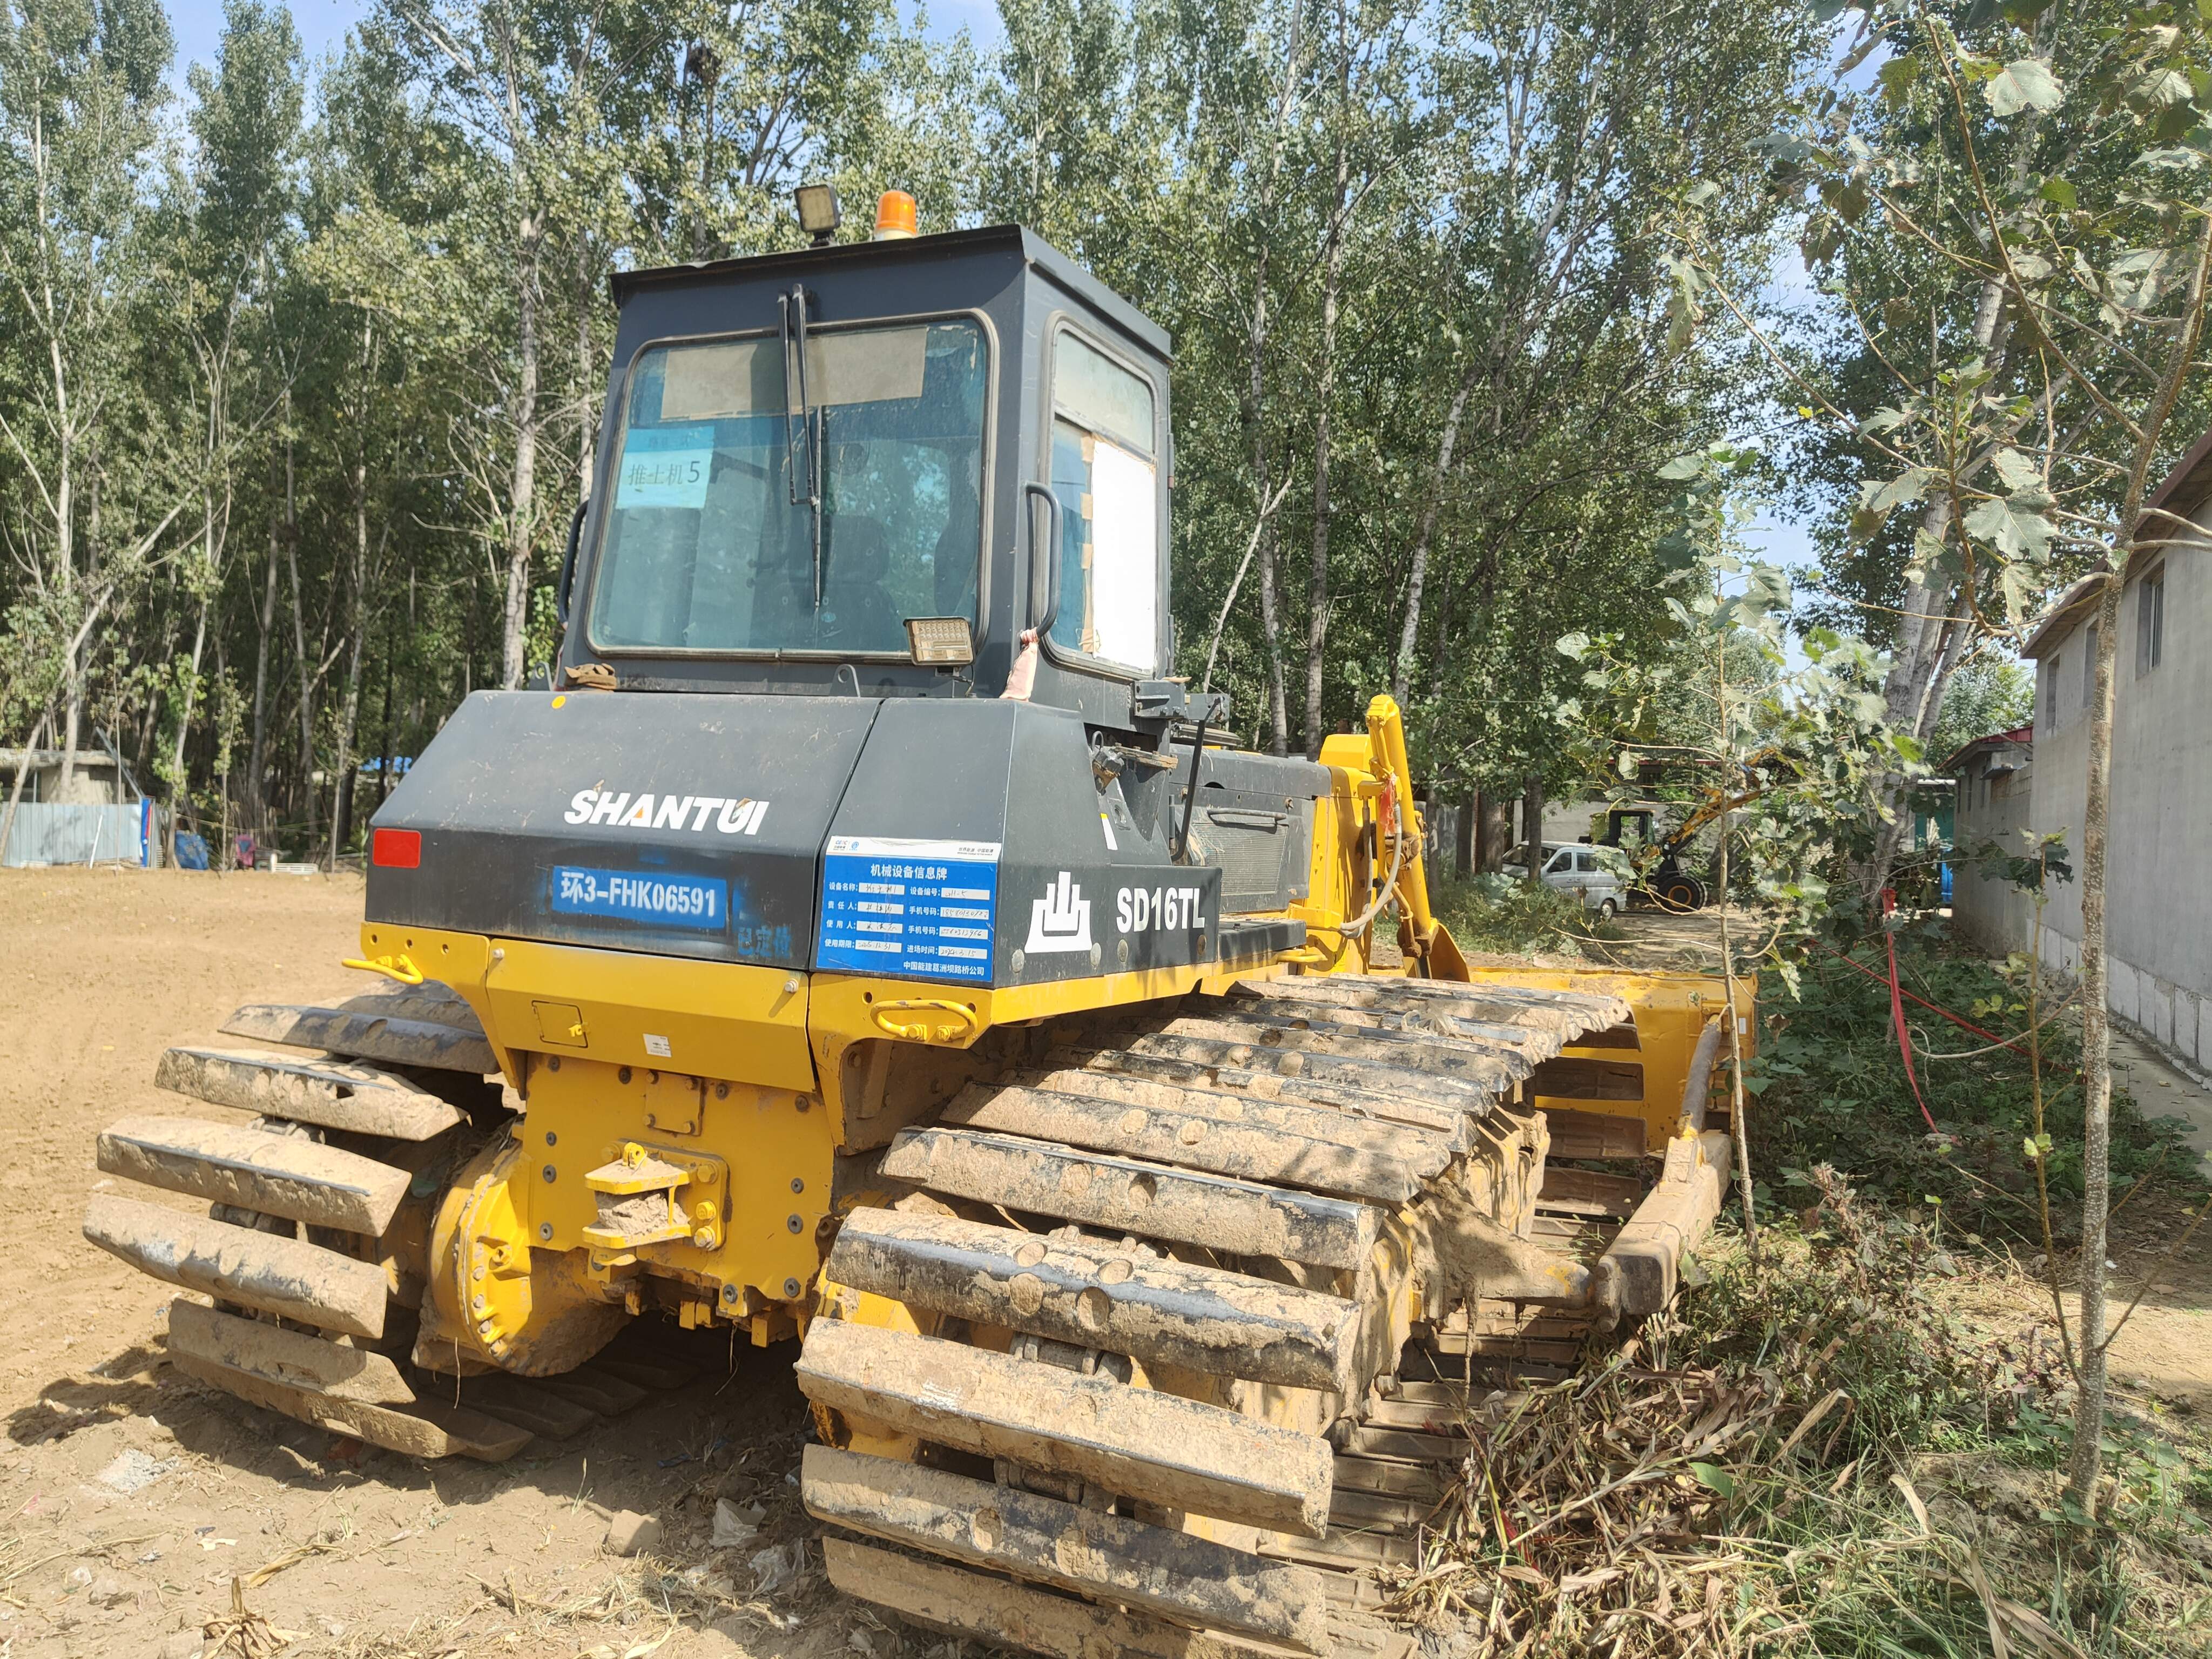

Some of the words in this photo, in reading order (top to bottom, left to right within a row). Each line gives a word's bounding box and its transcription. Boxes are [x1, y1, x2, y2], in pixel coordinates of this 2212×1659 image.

[564, 790, 770, 835] SHANTUI
[561, 872, 715, 917] 环3-FHK06591
[871, 864, 947, 881] 机械设备信息牌
[1116, 887, 1205, 934] SD16TL
[903, 961, 984, 975] 中国能建葛洲坝路桥公司
